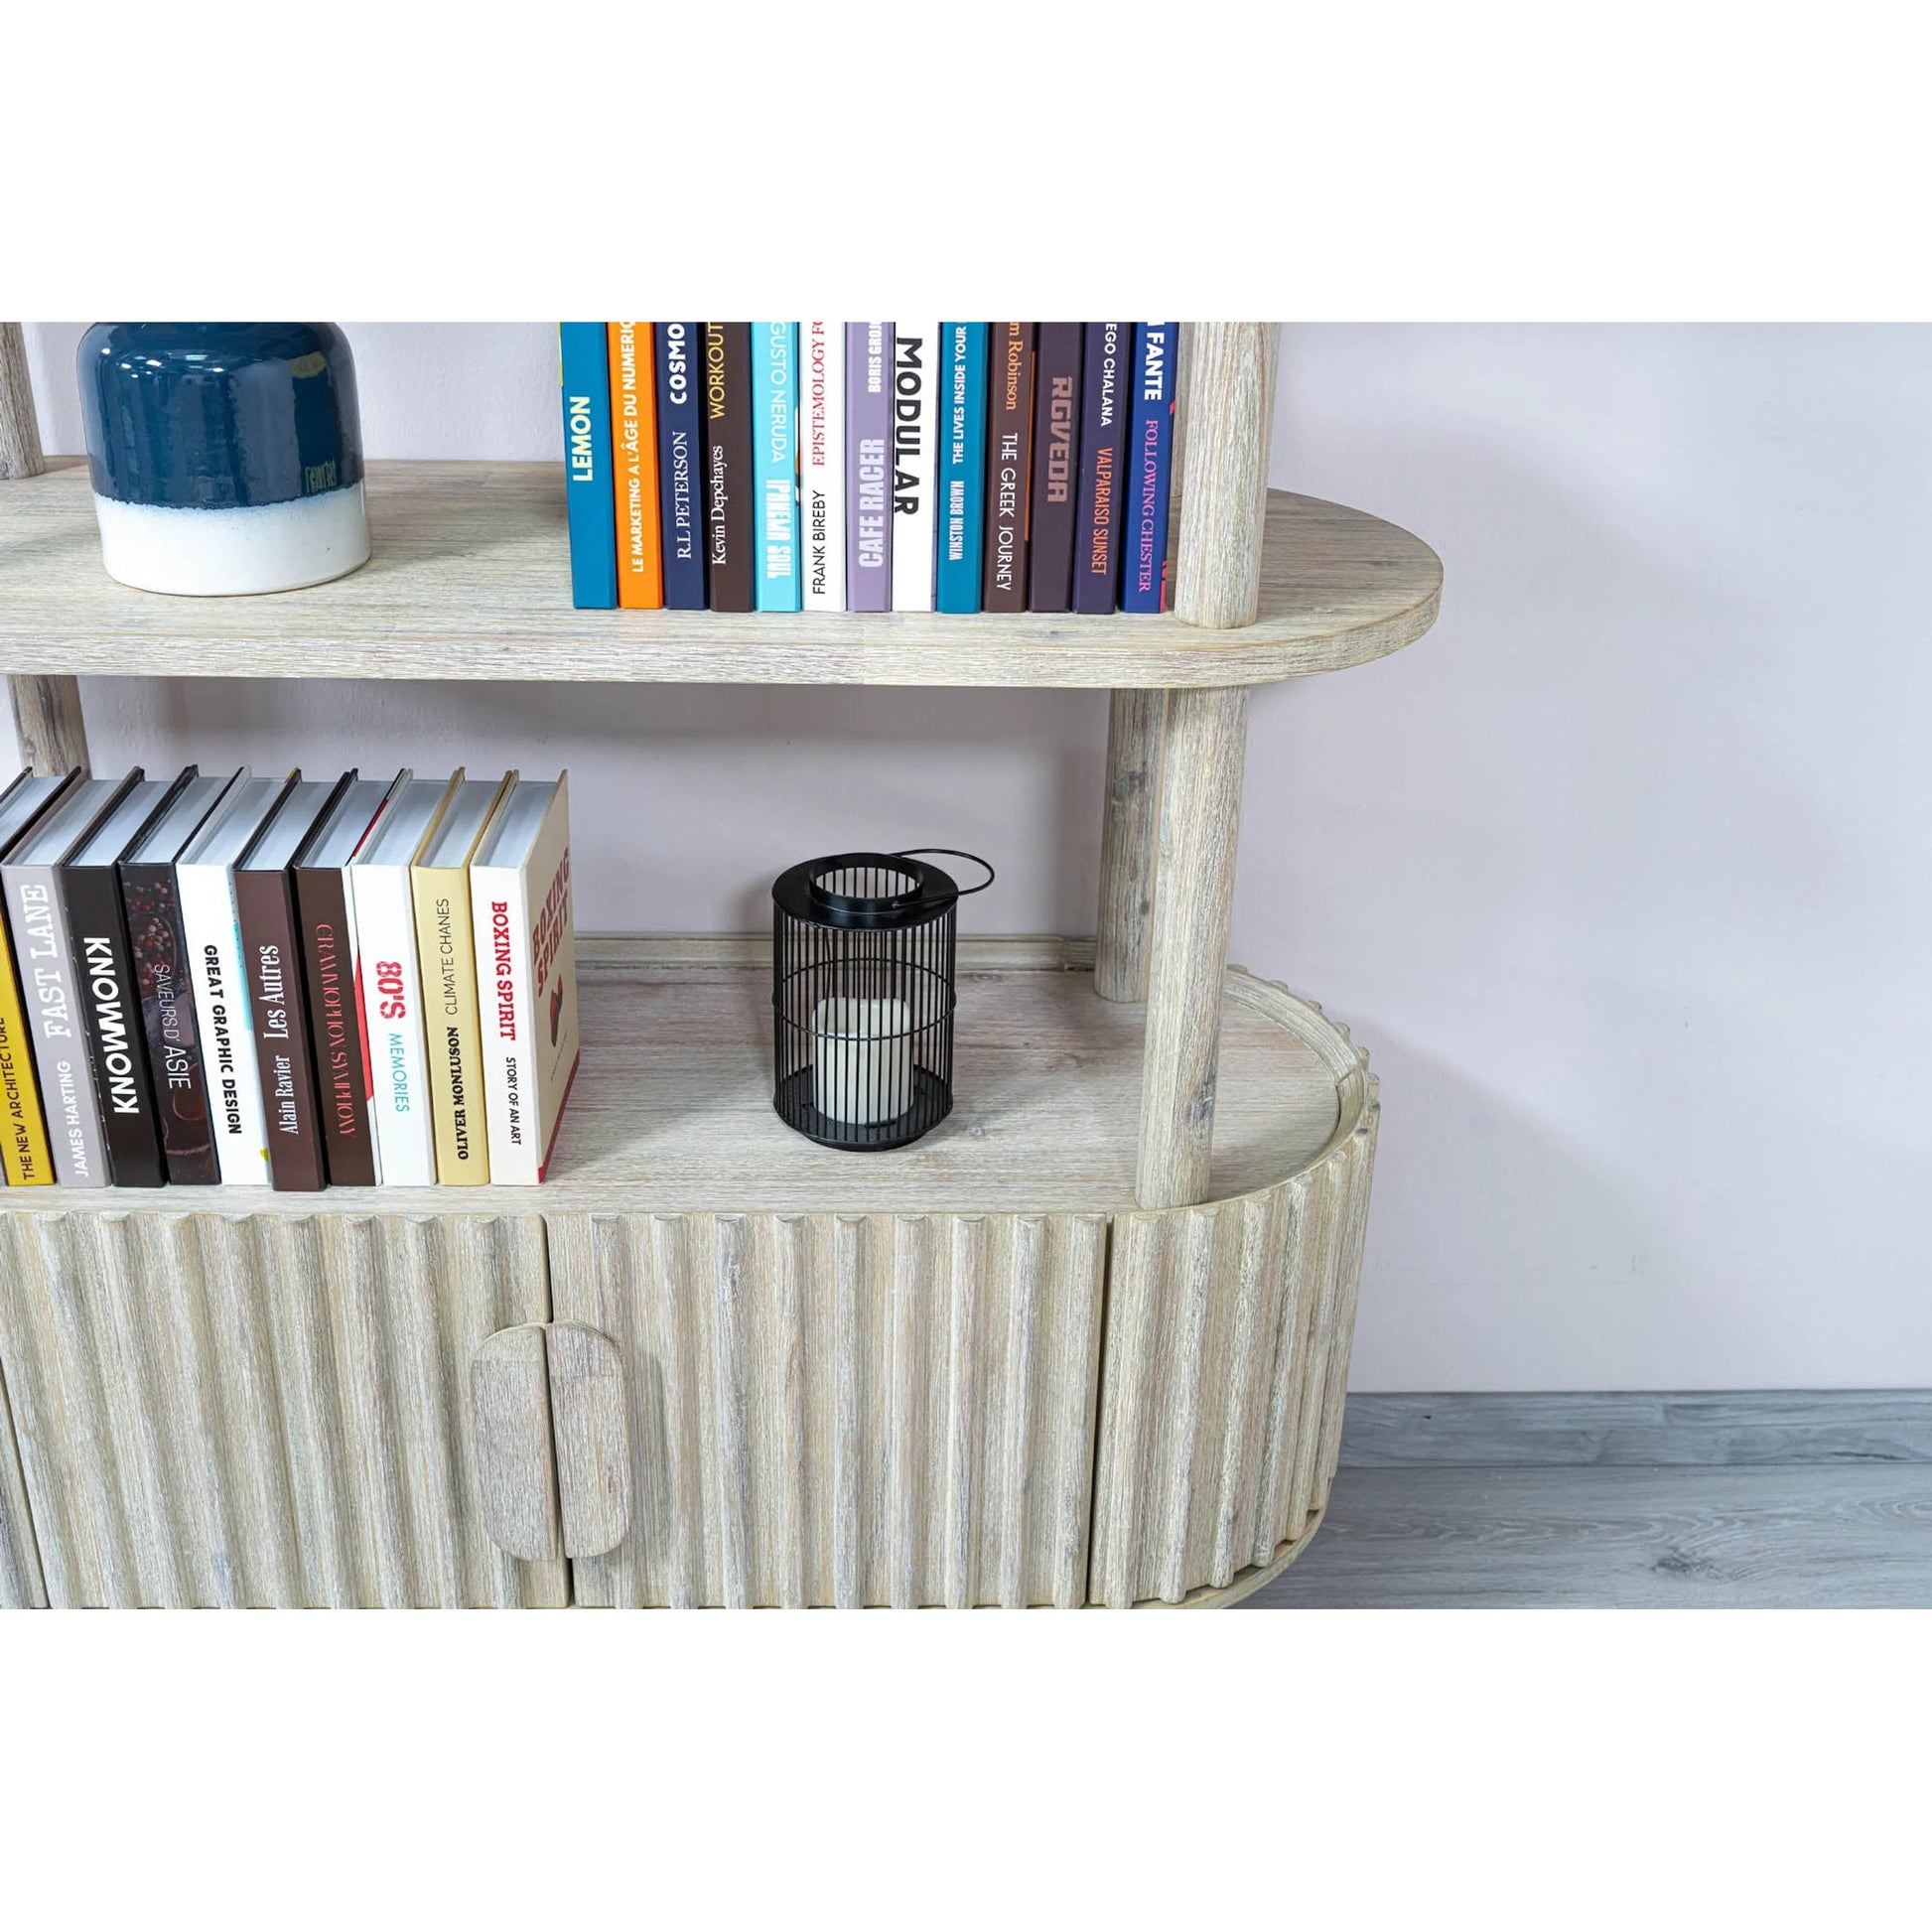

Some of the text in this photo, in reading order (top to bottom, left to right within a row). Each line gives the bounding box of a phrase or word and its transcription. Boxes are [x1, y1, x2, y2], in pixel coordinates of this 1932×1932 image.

[623, 395, 637, 417] DU
[667, 324, 686, 405] COSMO
[708, 322, 726, 420] WORKOUT
[811, 339, 824, 466] EPISTEMOLOGY
[868, 356, 883, 393] BORIS
[953, 326, 967, 464] THE LIVES INSIDE YOUR
[1006, 341, 1024, 410] Robinson
[1101, 358, 1115, 427] CHALANA
[1145, 332, 1165, 400] FANTE
[569, 396, 593, 482] LEMON
[770, 390, 786, 463] NERUDA
[895, 337, 922, 515] MODULAR
[626, 466, 639, 476] A
[672, 431, 690, 526] PETERSON
[710, 446, 729, 564] Kevin Depchayes
[859, 440, 885, 568] CAFE RACER
[997, 433, 1018, 591] THE GREEK JOURNEY
[1092, 448, 1113, 575] VALPARAISO SUNSET
[1139, 419, 1159, 593] FOLLOWING CHESTER
[626, 477, 643, 555] MARKETING
[812, 490, 825, 595] FRANK BIREBY
[949, 481, 965, 560] WINSTON BROWN
[631, 558, 643, 572] LE
[766, 546, 791, 579] SOUL
[21, 885, 71, 1039] FAST LANE
[155, 964, 179, 1035] SAVEURS
[259, 945, 289, 1039] Les Autres
[376, 961, 406, 1020] 80'S
[436, 897, 458, 1016] CLIMATE CHANES
[491, 901, 515, 1040] BOXING SPIRIT
[163, 1045, 191, 1089] ASIE
[205, 944, 242, 1135] GREAT GRAPHIC DESIGN
[389, 1033, 409, 1113] MEMORIES
[57, 1060, 88, 1177] JAMES HARTING
[273, 1055, 299, 1135] Alain Ravier
[449, 1027, 469, 1161] OLIVER MONLUSON
[506, 1057, 521, 1145] STORY OF AN ART
[13, 1124, 31, 1153] NEW
[20, 1156, 35, 1179] THE
